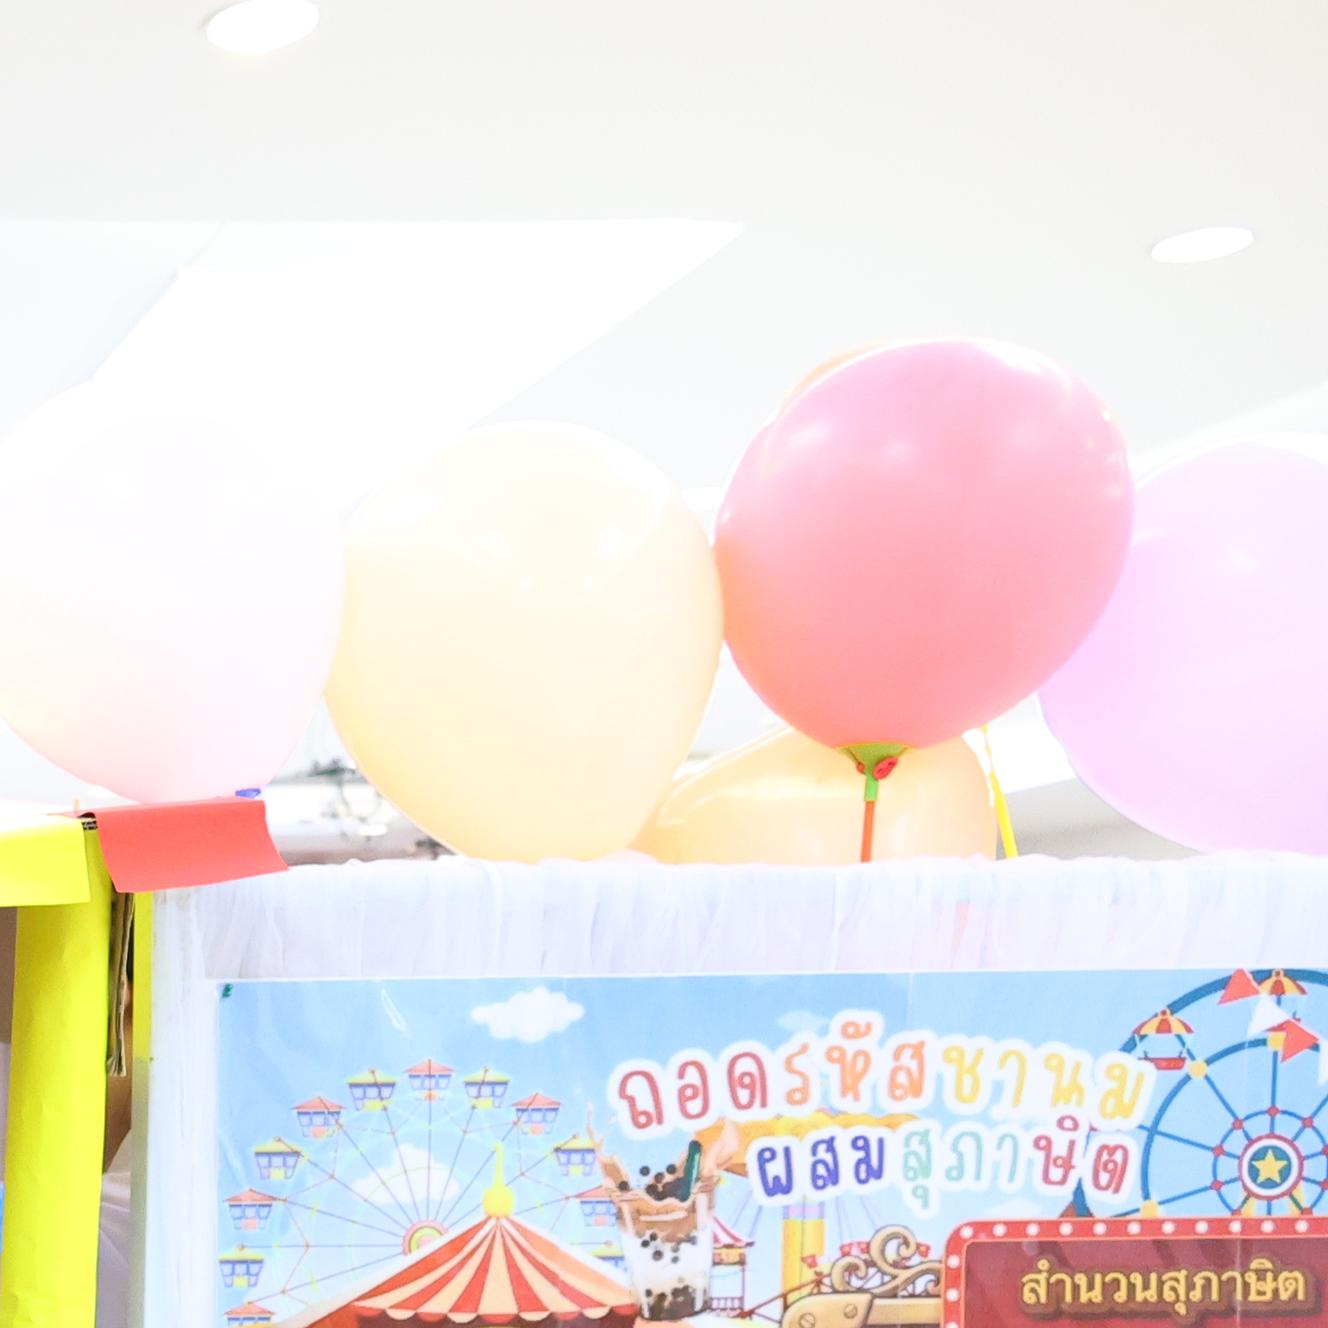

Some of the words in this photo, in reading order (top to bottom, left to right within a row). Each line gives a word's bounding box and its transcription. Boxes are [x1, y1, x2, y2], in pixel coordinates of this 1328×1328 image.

[756, 1116, 1130, 1210] ผสมสุภาษิต
[1021, 1257, 1306, 1315] สำนวนสุภาษิต
